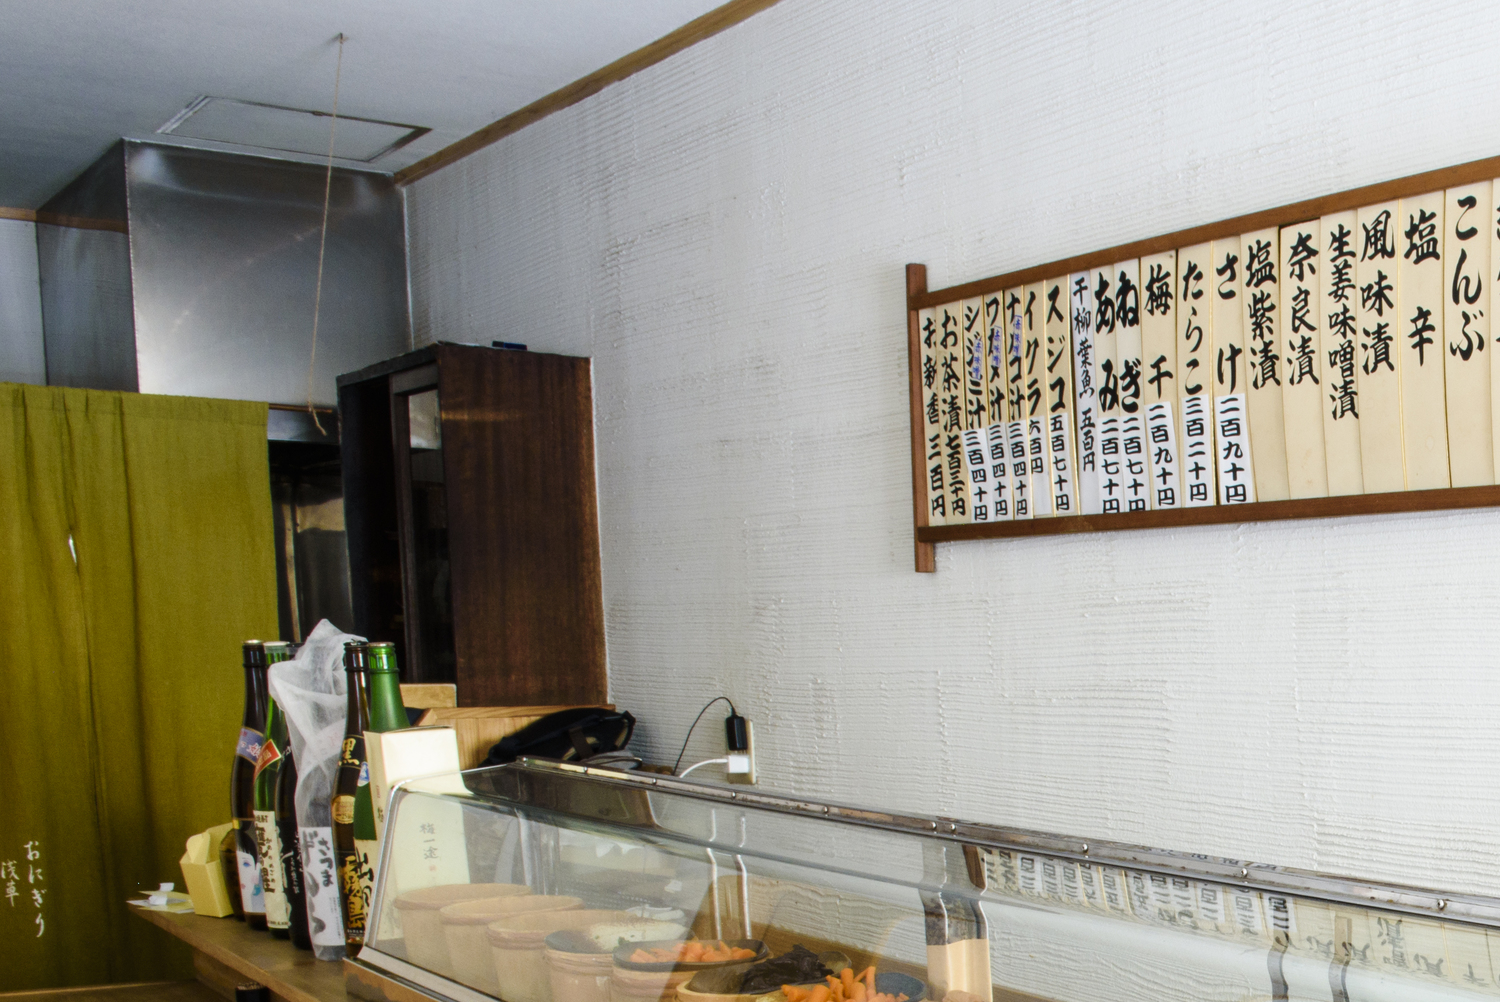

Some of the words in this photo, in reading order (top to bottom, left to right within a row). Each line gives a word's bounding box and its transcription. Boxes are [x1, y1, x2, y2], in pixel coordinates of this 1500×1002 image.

[1144, 263, 1173, 400] 梅干
[1182, 260, 1204, 396] たらこ
[1216, 252, 1243, 394] さけ
[1287, 231, 1320, 385] 奈良漬
[1327, 224, 1359, 420] 生姜味噌漬
[1360, 209, 1396, 375] 風味漬
[1404, 208, 1441, 367] 塩辛
[1450, 195, 1485, 361] こんぶ
[940, 308, 962, 432] お茶漬
[1024, 291, 1041, 416] イクラ
[1046, 284, 1066, 413] スジコ
[1095, 271, 1119, 412] あみ
[1116, 270, 1141, 413] ねぎ
[964, 430, 988, 521] 三百四十円
[989, 424, 1008, 516] 三百四十円
[1008, 422, 1028, 516] 三百四十円
[1028, 418, 1044, 474] 六百円
[1050, 414, 1069, 511] 五百七十円
[1080, 407, 1096, 472] 五百円
[1101, 418, 1120, 513] 二百七十円
[1123, 417, 1146, 512] 二百七十円
[1149, 404, 1176, 506] 二百九十円
[1185, 397, 1208, 502] 三百二十円
[1219, 397, 1247, 503] 二百九十円
[24, 841, 47, 938] おにぎり
